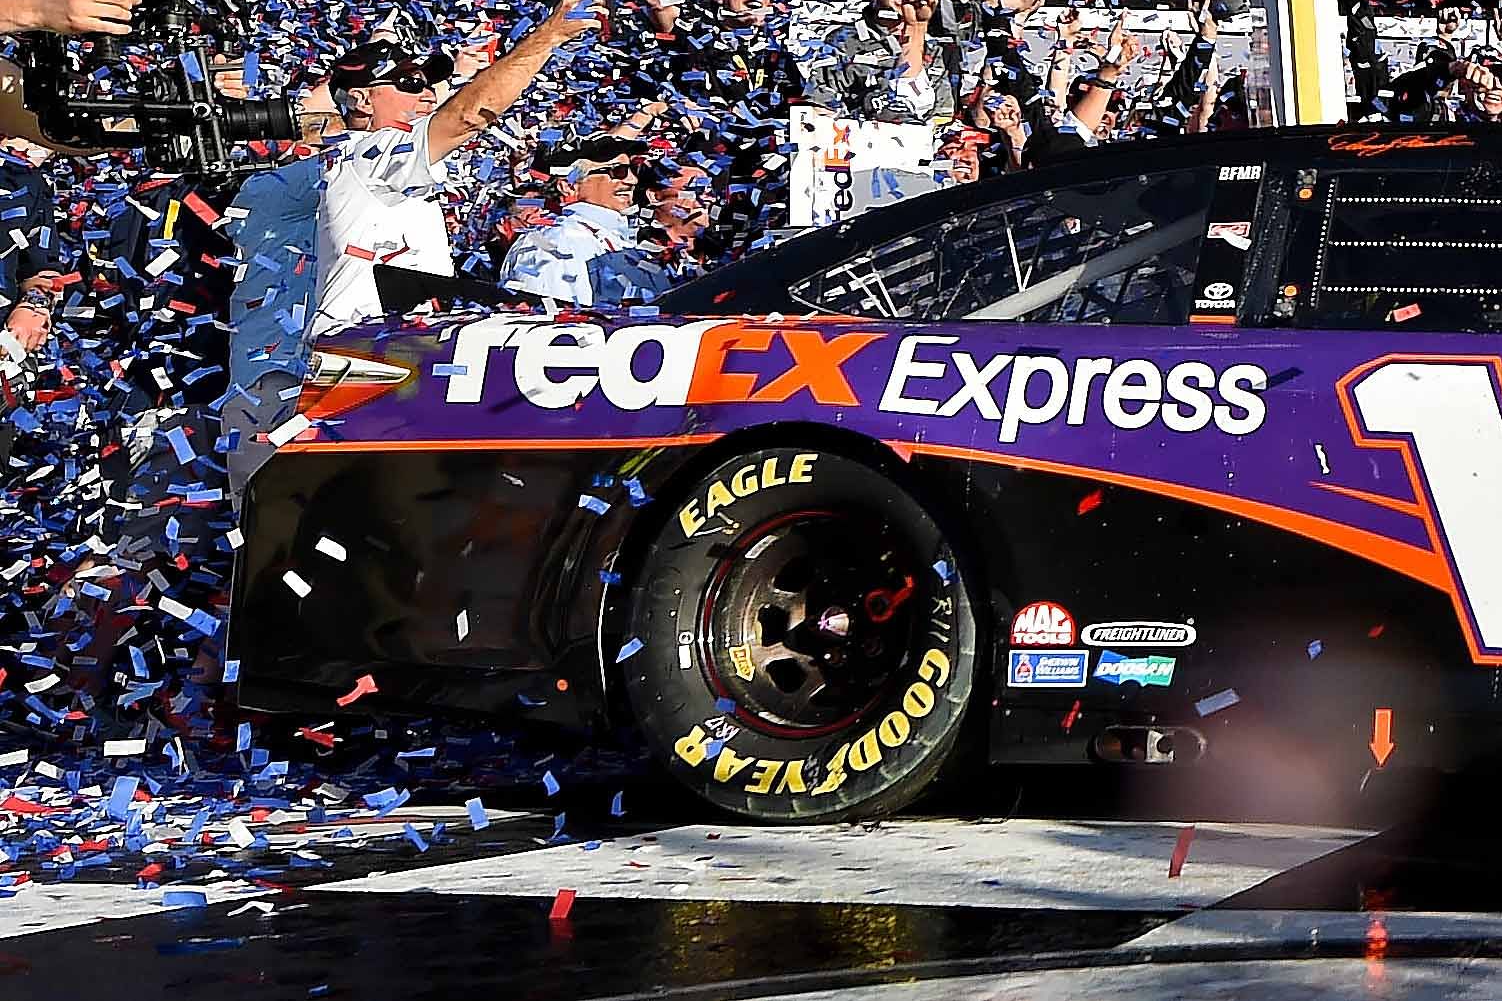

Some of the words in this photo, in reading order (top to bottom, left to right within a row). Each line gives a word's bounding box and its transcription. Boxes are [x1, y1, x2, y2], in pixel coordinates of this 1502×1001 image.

[1194, 299, 1236, 309] TOYOTA
[879, 335, 1270, 442] Express
[679, 453, 819, 539] EAGLE
[1013, 604, 1073, 633] MAC
[1013, 632, 1072, 645] TOOLS
[1091, 627, 1187, 642] FREIGHTLINER
[1097, 661, 1175, 677] DOOSAN
[674, 647, 951, 797] GOODYEAR
